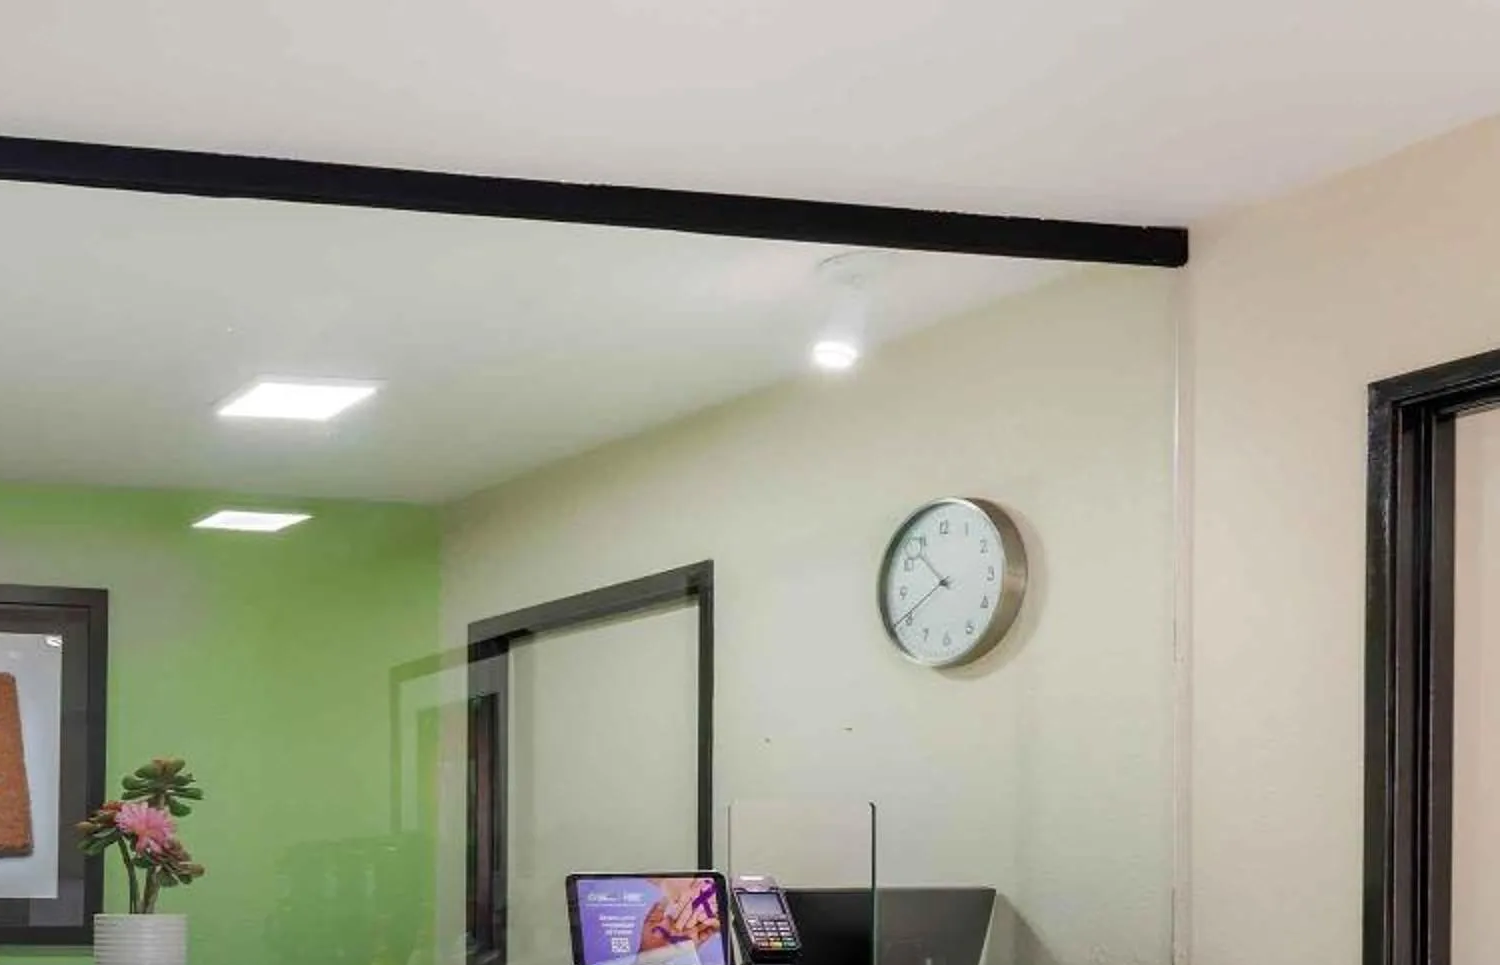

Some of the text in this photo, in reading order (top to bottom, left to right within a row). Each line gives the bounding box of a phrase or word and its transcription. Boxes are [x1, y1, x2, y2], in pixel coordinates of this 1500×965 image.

[939, 519, 950, 535] 12
[980, 539, 989, 554] 2
[987, 566, 995, 581] 3
[899, 586, 908, 600] 9
[980, 595, 989, 609] 4
[922, 627, 930, 642] 7
[965, 620, 974, 635] 5
[942, 630, 951, 646] 6
